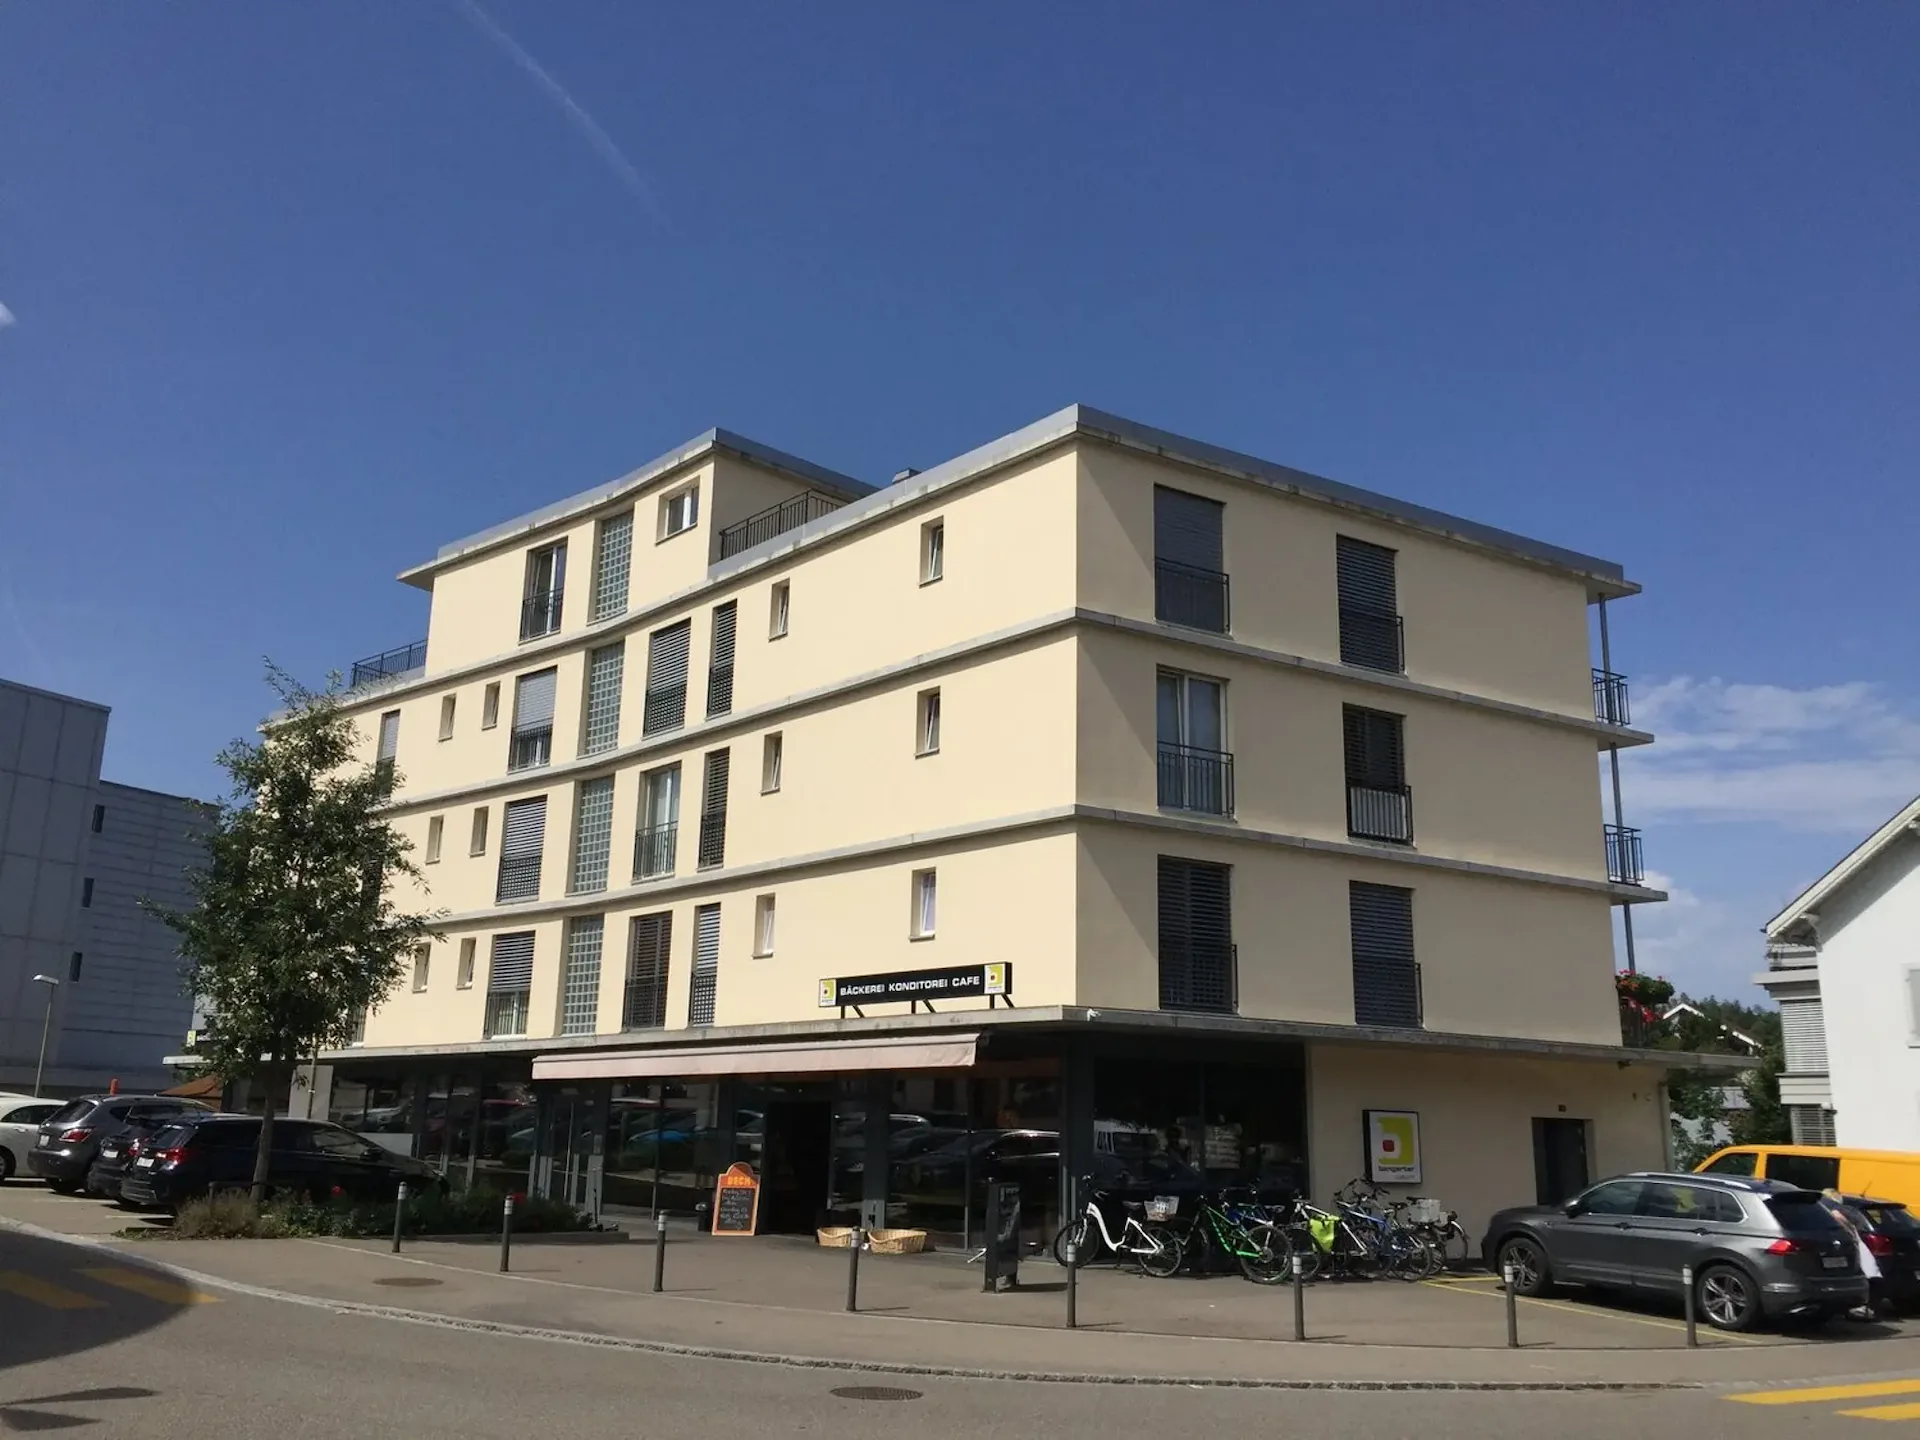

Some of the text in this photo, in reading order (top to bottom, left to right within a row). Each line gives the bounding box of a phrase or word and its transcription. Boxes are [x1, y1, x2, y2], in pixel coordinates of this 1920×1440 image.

[840, 975, 980, 996] BÄCKEREI KONDITOREI CAFE
